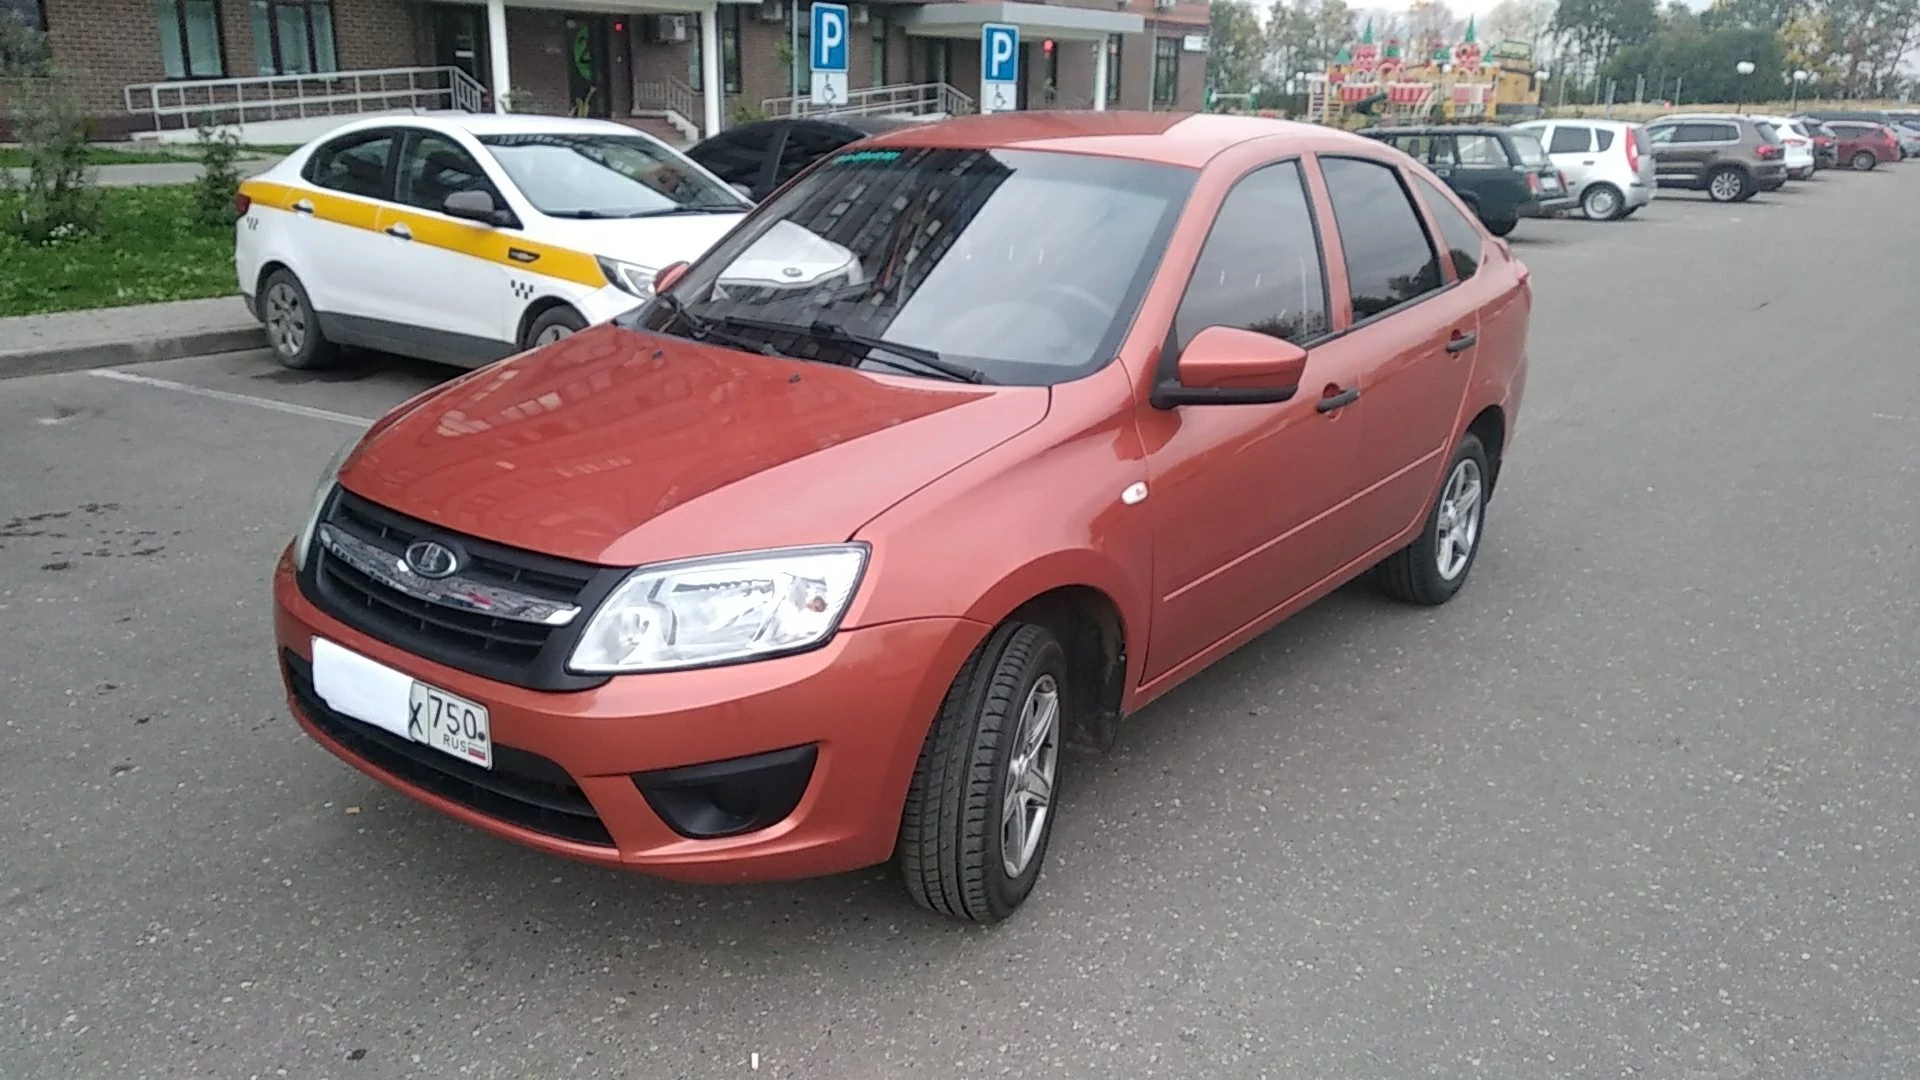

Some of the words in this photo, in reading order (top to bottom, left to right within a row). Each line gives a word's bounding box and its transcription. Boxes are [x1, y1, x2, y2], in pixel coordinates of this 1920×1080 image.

[821, 12, 843, 65] P
[991, 31, 1013, 77] P
[430, 694, 477, 740] 750
[443, 733, 467, 753] RUS
